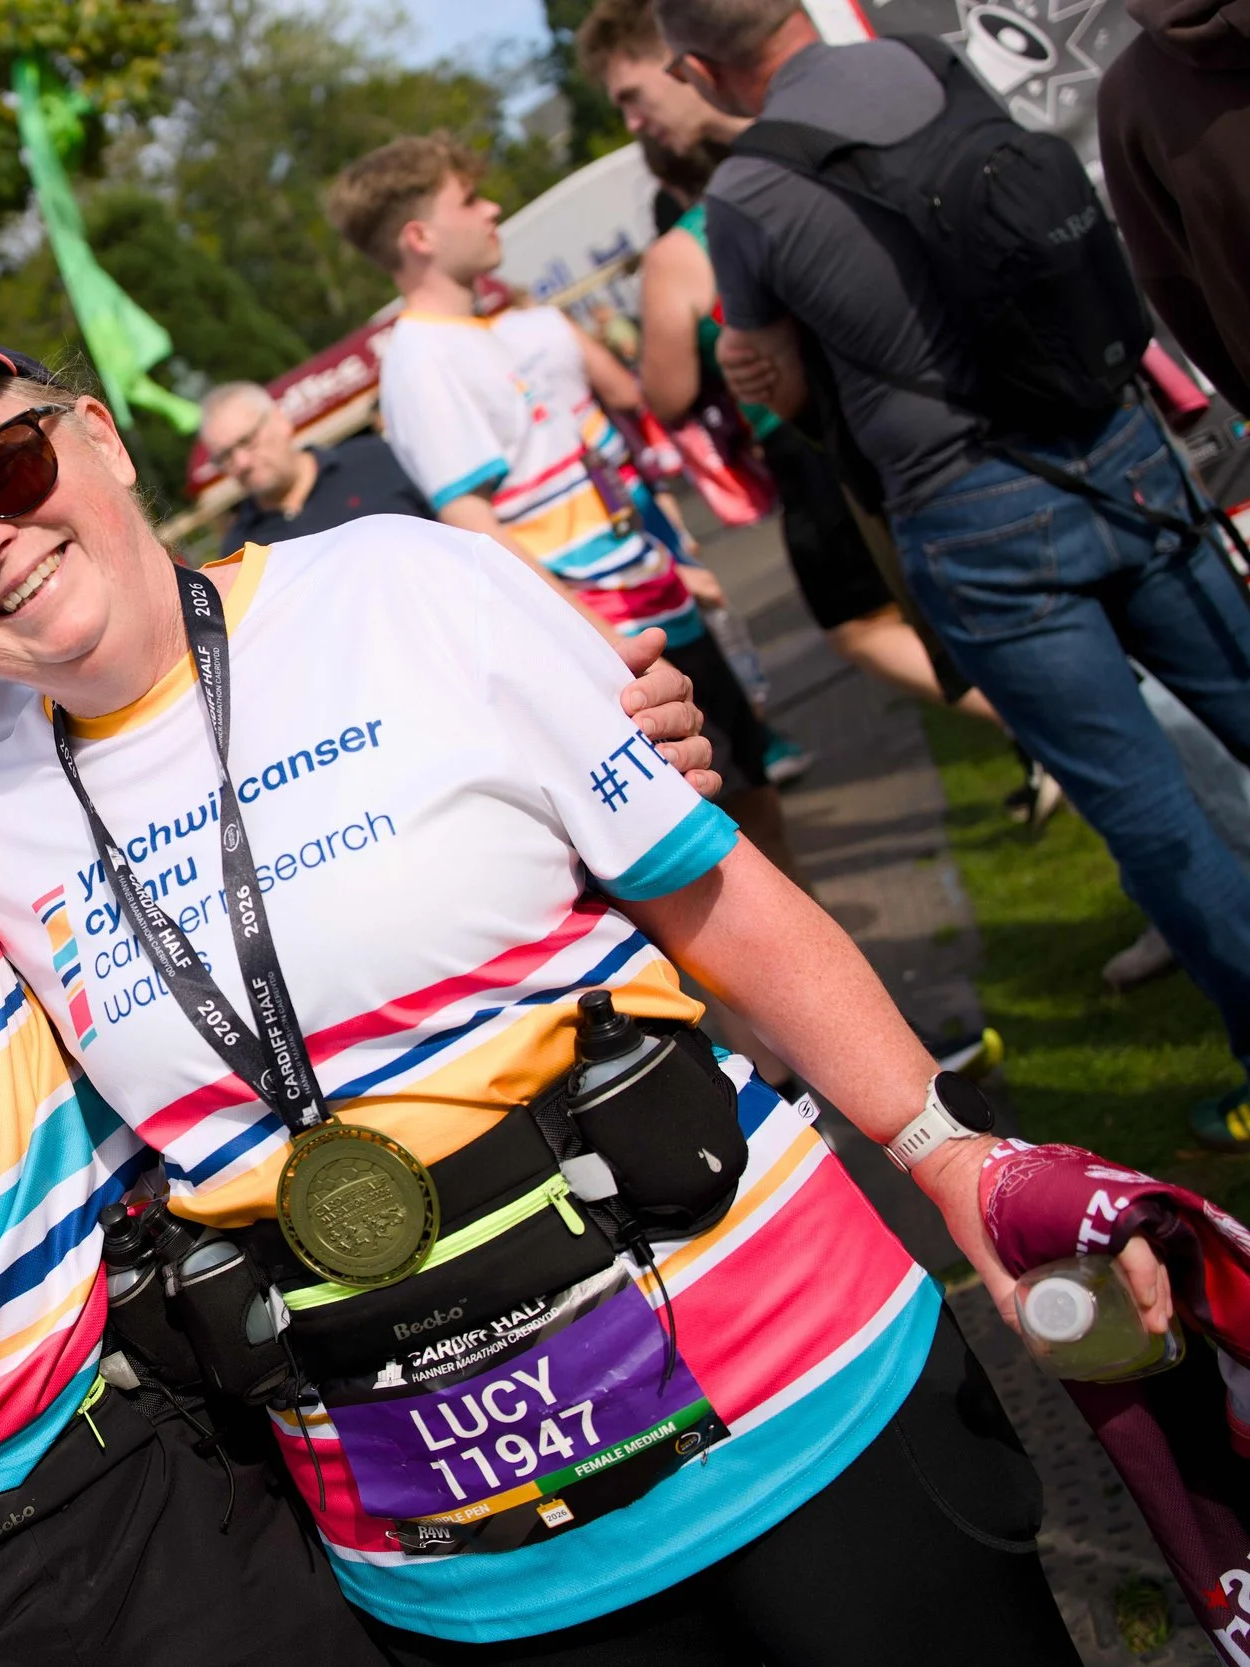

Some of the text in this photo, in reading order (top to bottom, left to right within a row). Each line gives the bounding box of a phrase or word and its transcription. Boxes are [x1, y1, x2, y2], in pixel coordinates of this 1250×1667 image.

[190, 583, 211, 617] 2026
[198, 646, 212, 687] HALF
[237, 719, 382, 804] canser
[117, 874, 176, 979] HANNER MARATHON CAERDYDD
[129, 874, 192, 970] CARDIFF HALF
[236, 885, 259, 938] 2026
[197, 1000, 240, 1046] 2026
[252, 977, 300, 1100] CARDIFF HALF
[408, 1294, 548, 1368] CARDIFF HALF
[412, 1307, 559, 1383] HANNER MARATHON CAERDYDD
[409, 1356, 557, 1452] LUCY
[430, 1399, 602, 1501] 11947
[575, 1447, 625, 1478] FEMALE
[624, 1421, 677, 1456] MEDIUM
[465, 1503, 491, 1520] PEN
[545, 1509, 568, 1522] 2026
